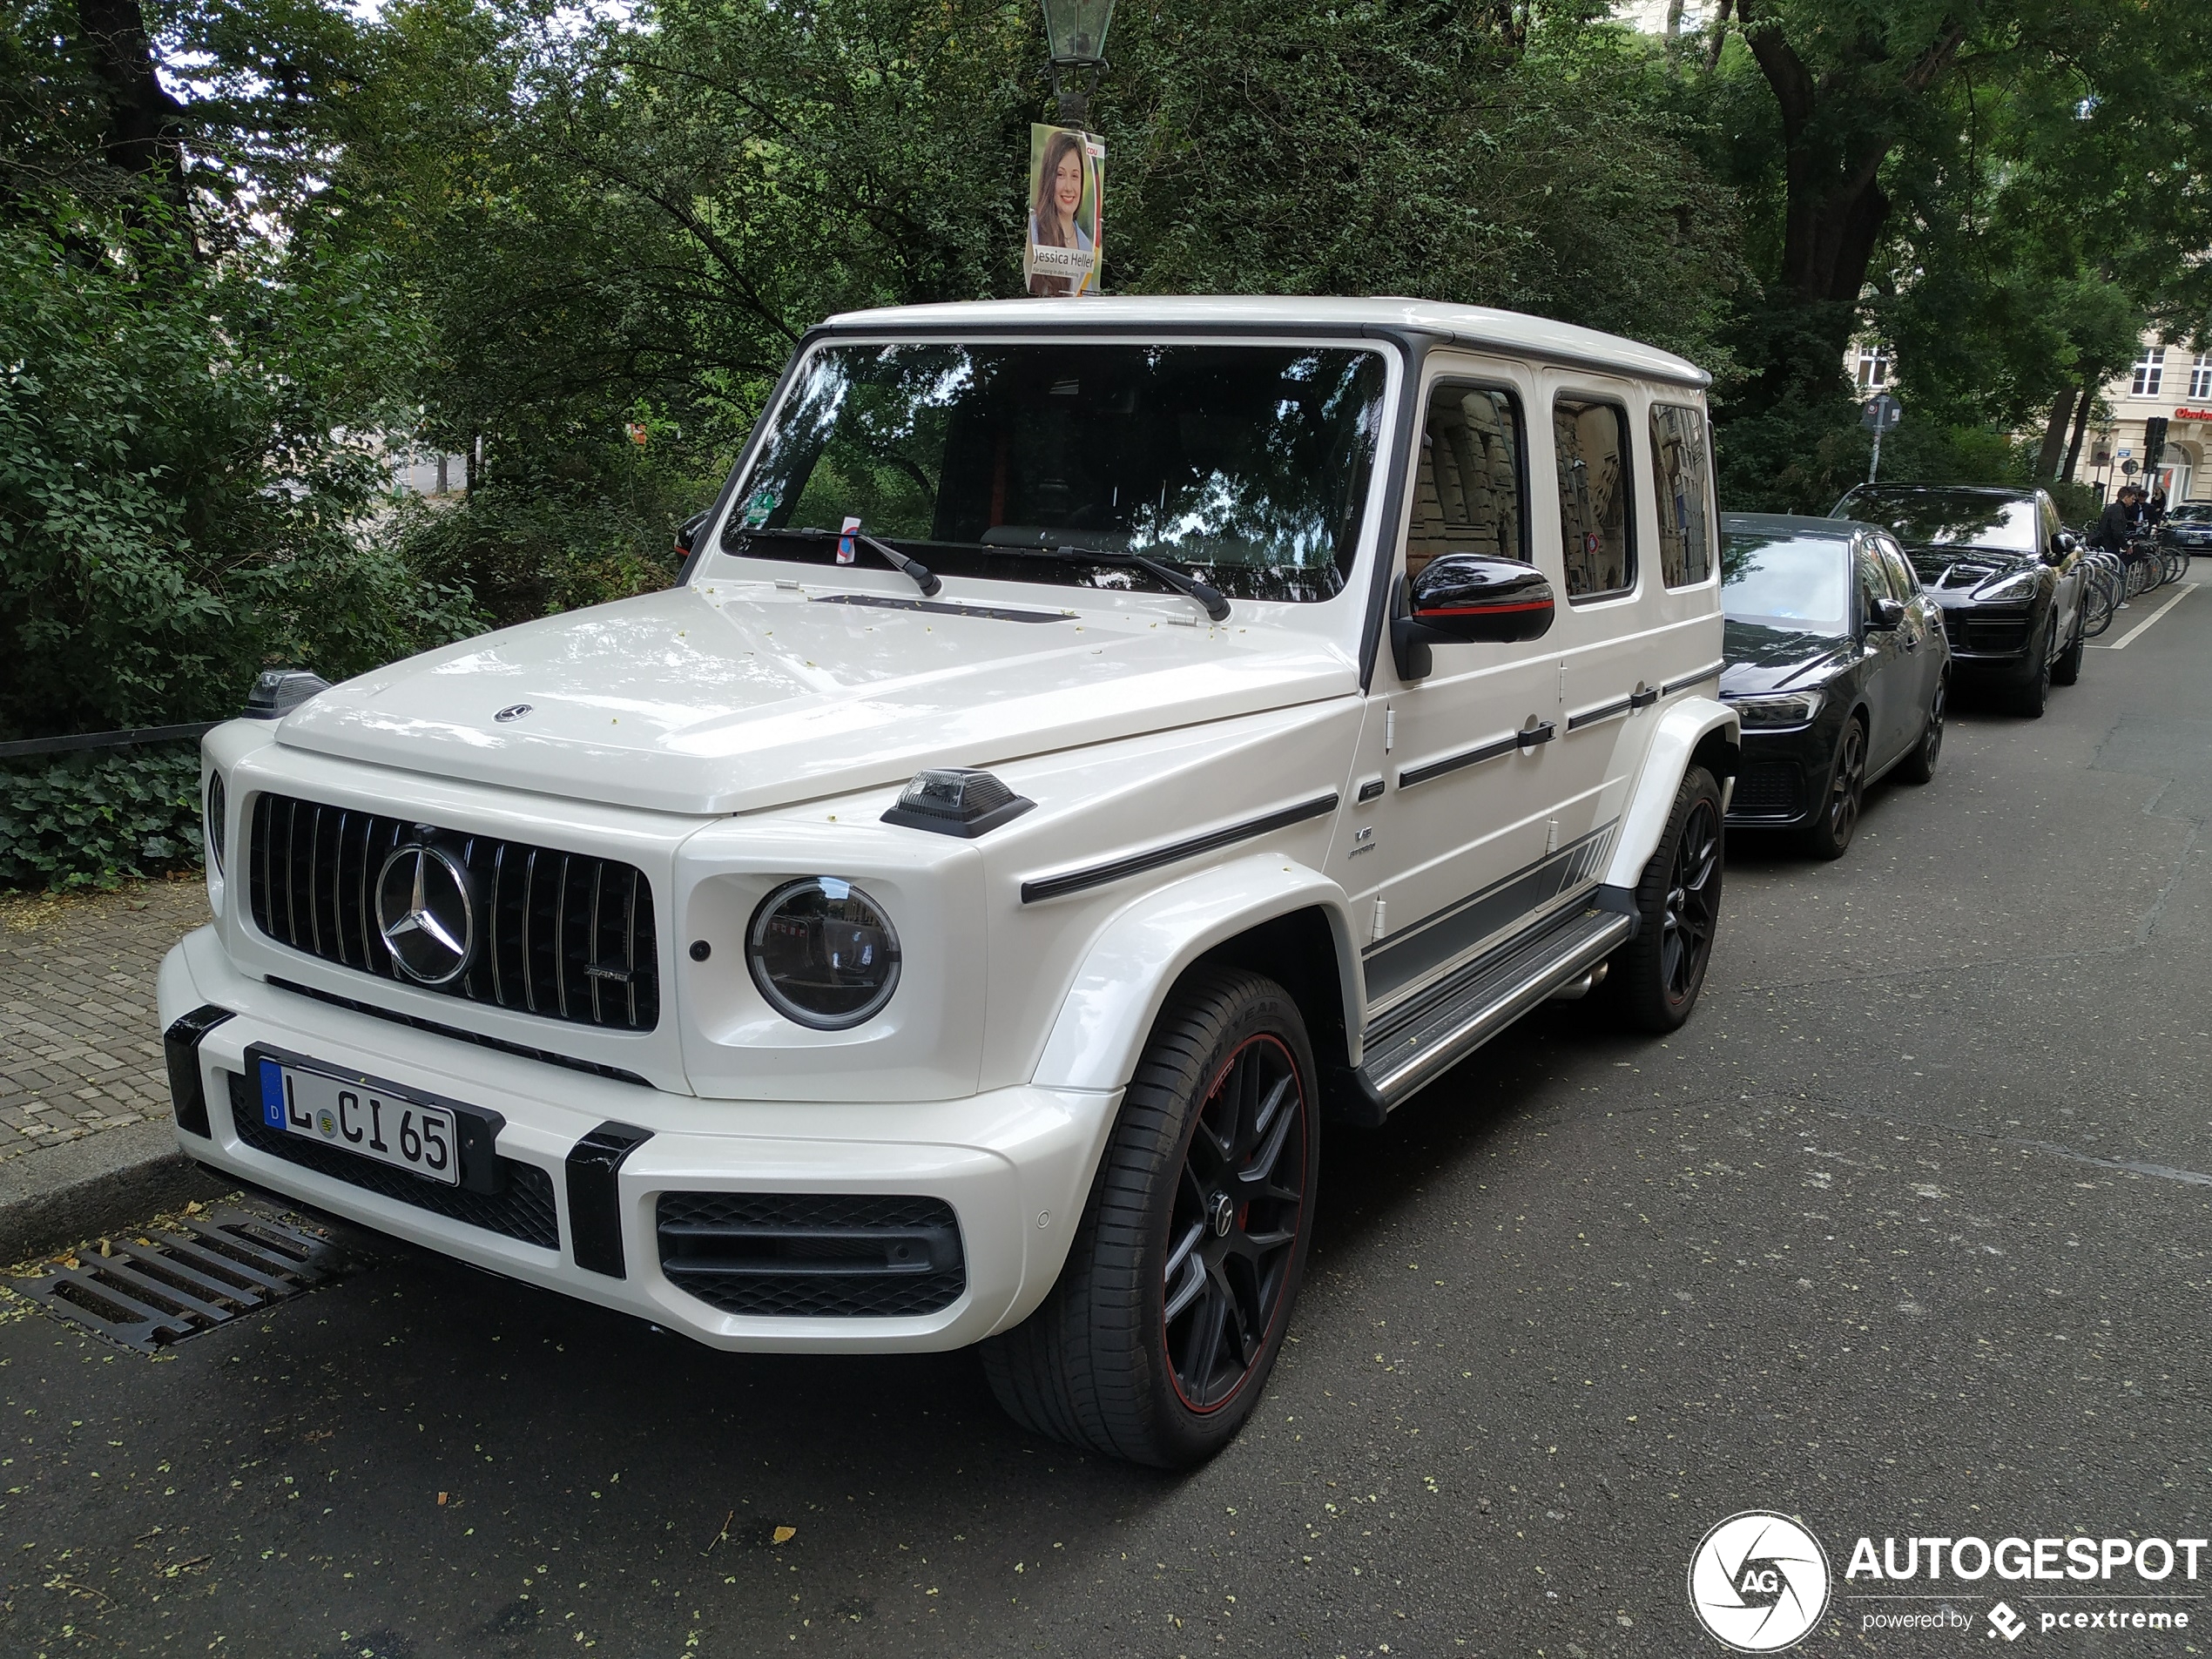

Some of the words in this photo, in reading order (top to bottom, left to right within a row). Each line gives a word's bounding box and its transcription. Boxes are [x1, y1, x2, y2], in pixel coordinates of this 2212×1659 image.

[1087, 147, 1098, 156] CDU
[1034, 248, 1069, 265] Jessica
[1071, 253, 1094, 268] Heller
[597, 970, 628, 982] AMG
[271, 1105, 280, 1121] D
[286, 1075, 313, 1130] L
[338, 1090, 388, 1153] CI
[400, 1110, 448, 1170] 65
